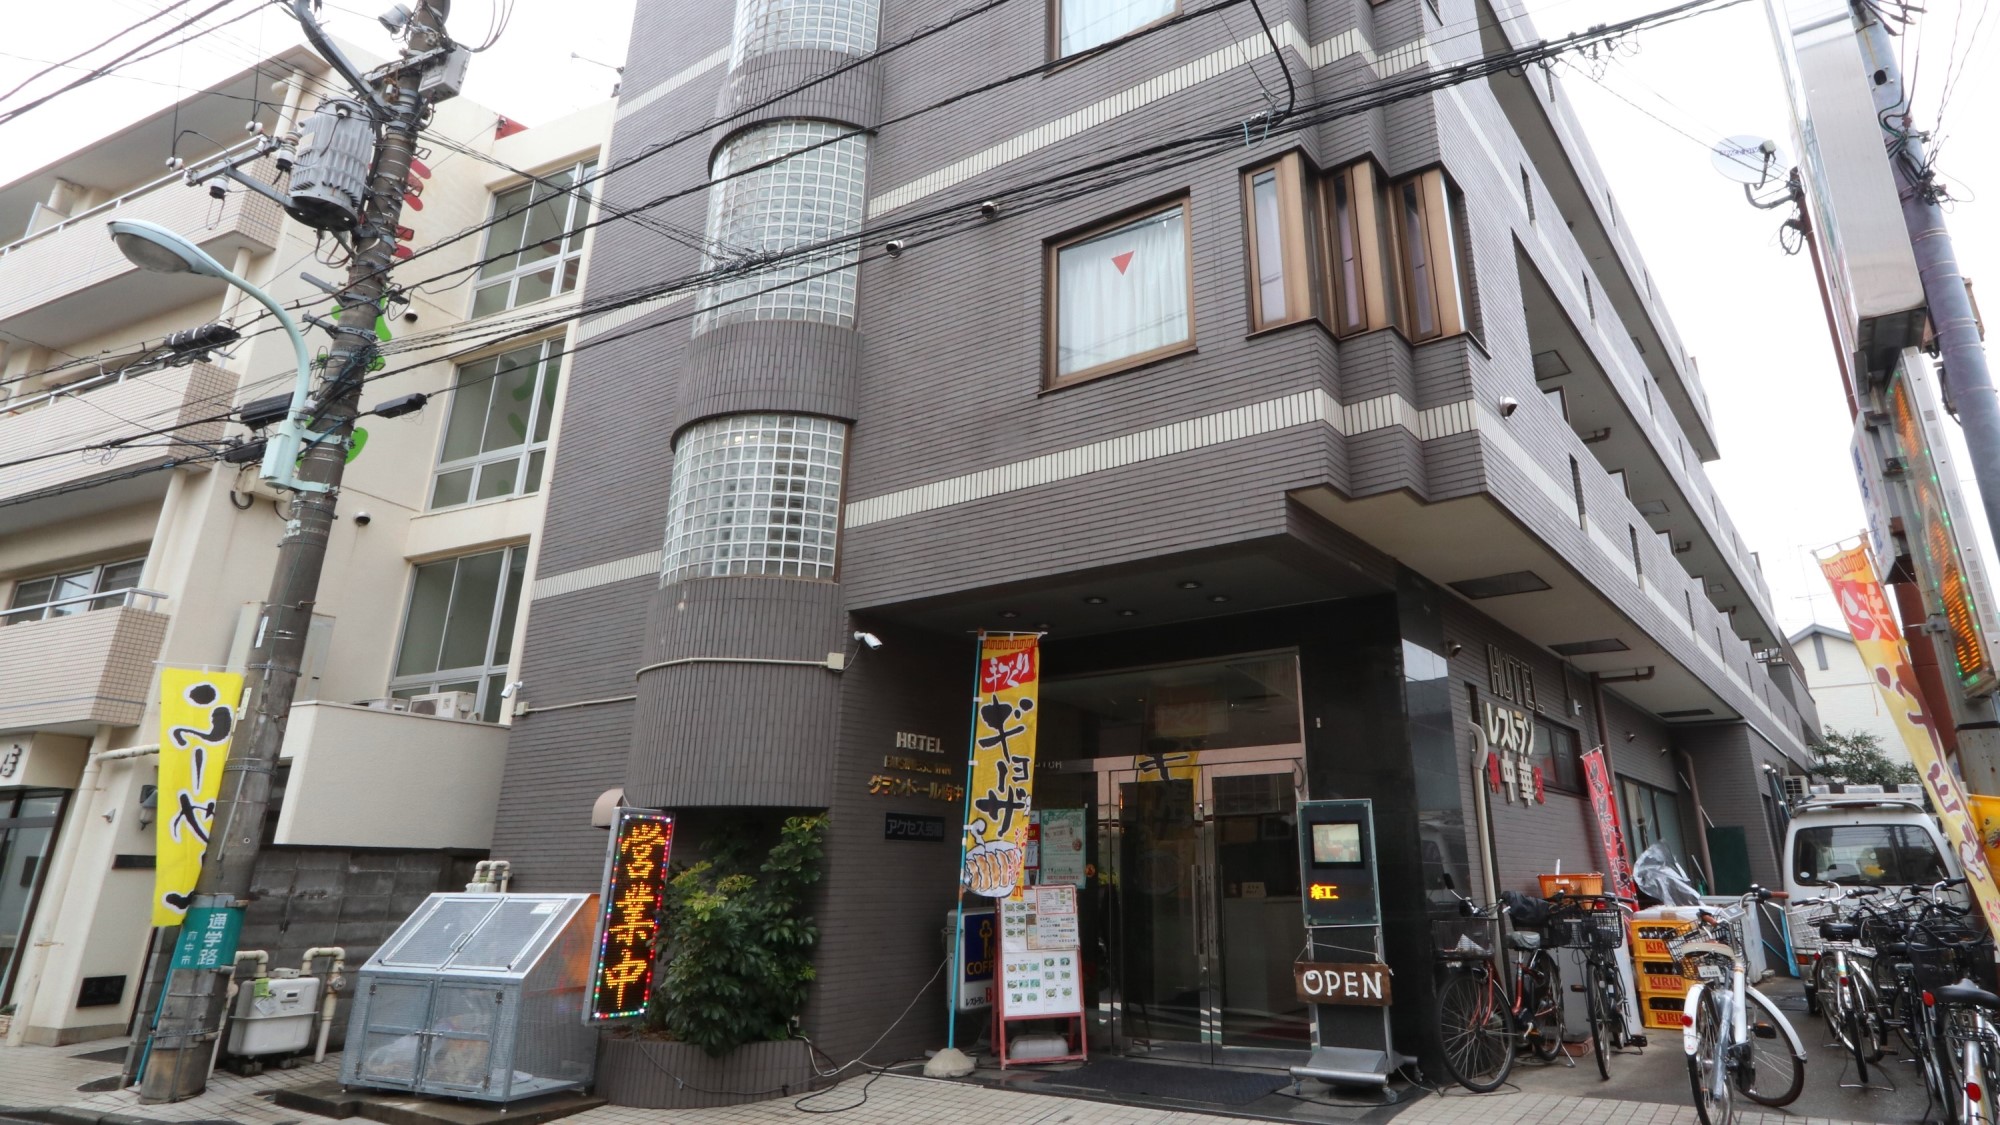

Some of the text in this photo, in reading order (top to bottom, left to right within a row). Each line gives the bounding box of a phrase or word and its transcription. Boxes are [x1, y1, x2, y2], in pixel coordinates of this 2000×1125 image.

[985, 652, 1030, 693] 手づくり
[1487, 643, 1545, 714] HOTEL
[896, 731, 945, 754] HOTEL
[1485, 702, 1534, 756] レストラン
[974, 694, 1034, 838] ギョーザ
[1500, 750, 1535, 806] 中華
[1310, 883, 1339, 900] 紅
[180, 930, 199, 965] 府中市
[196, 912, 228, 966] 通学路
[1645, 940, 1668, 953] KIR
[1303, 969, 1383, 999] OPEN
[1650, 976, 1682, 987] KIRIN
